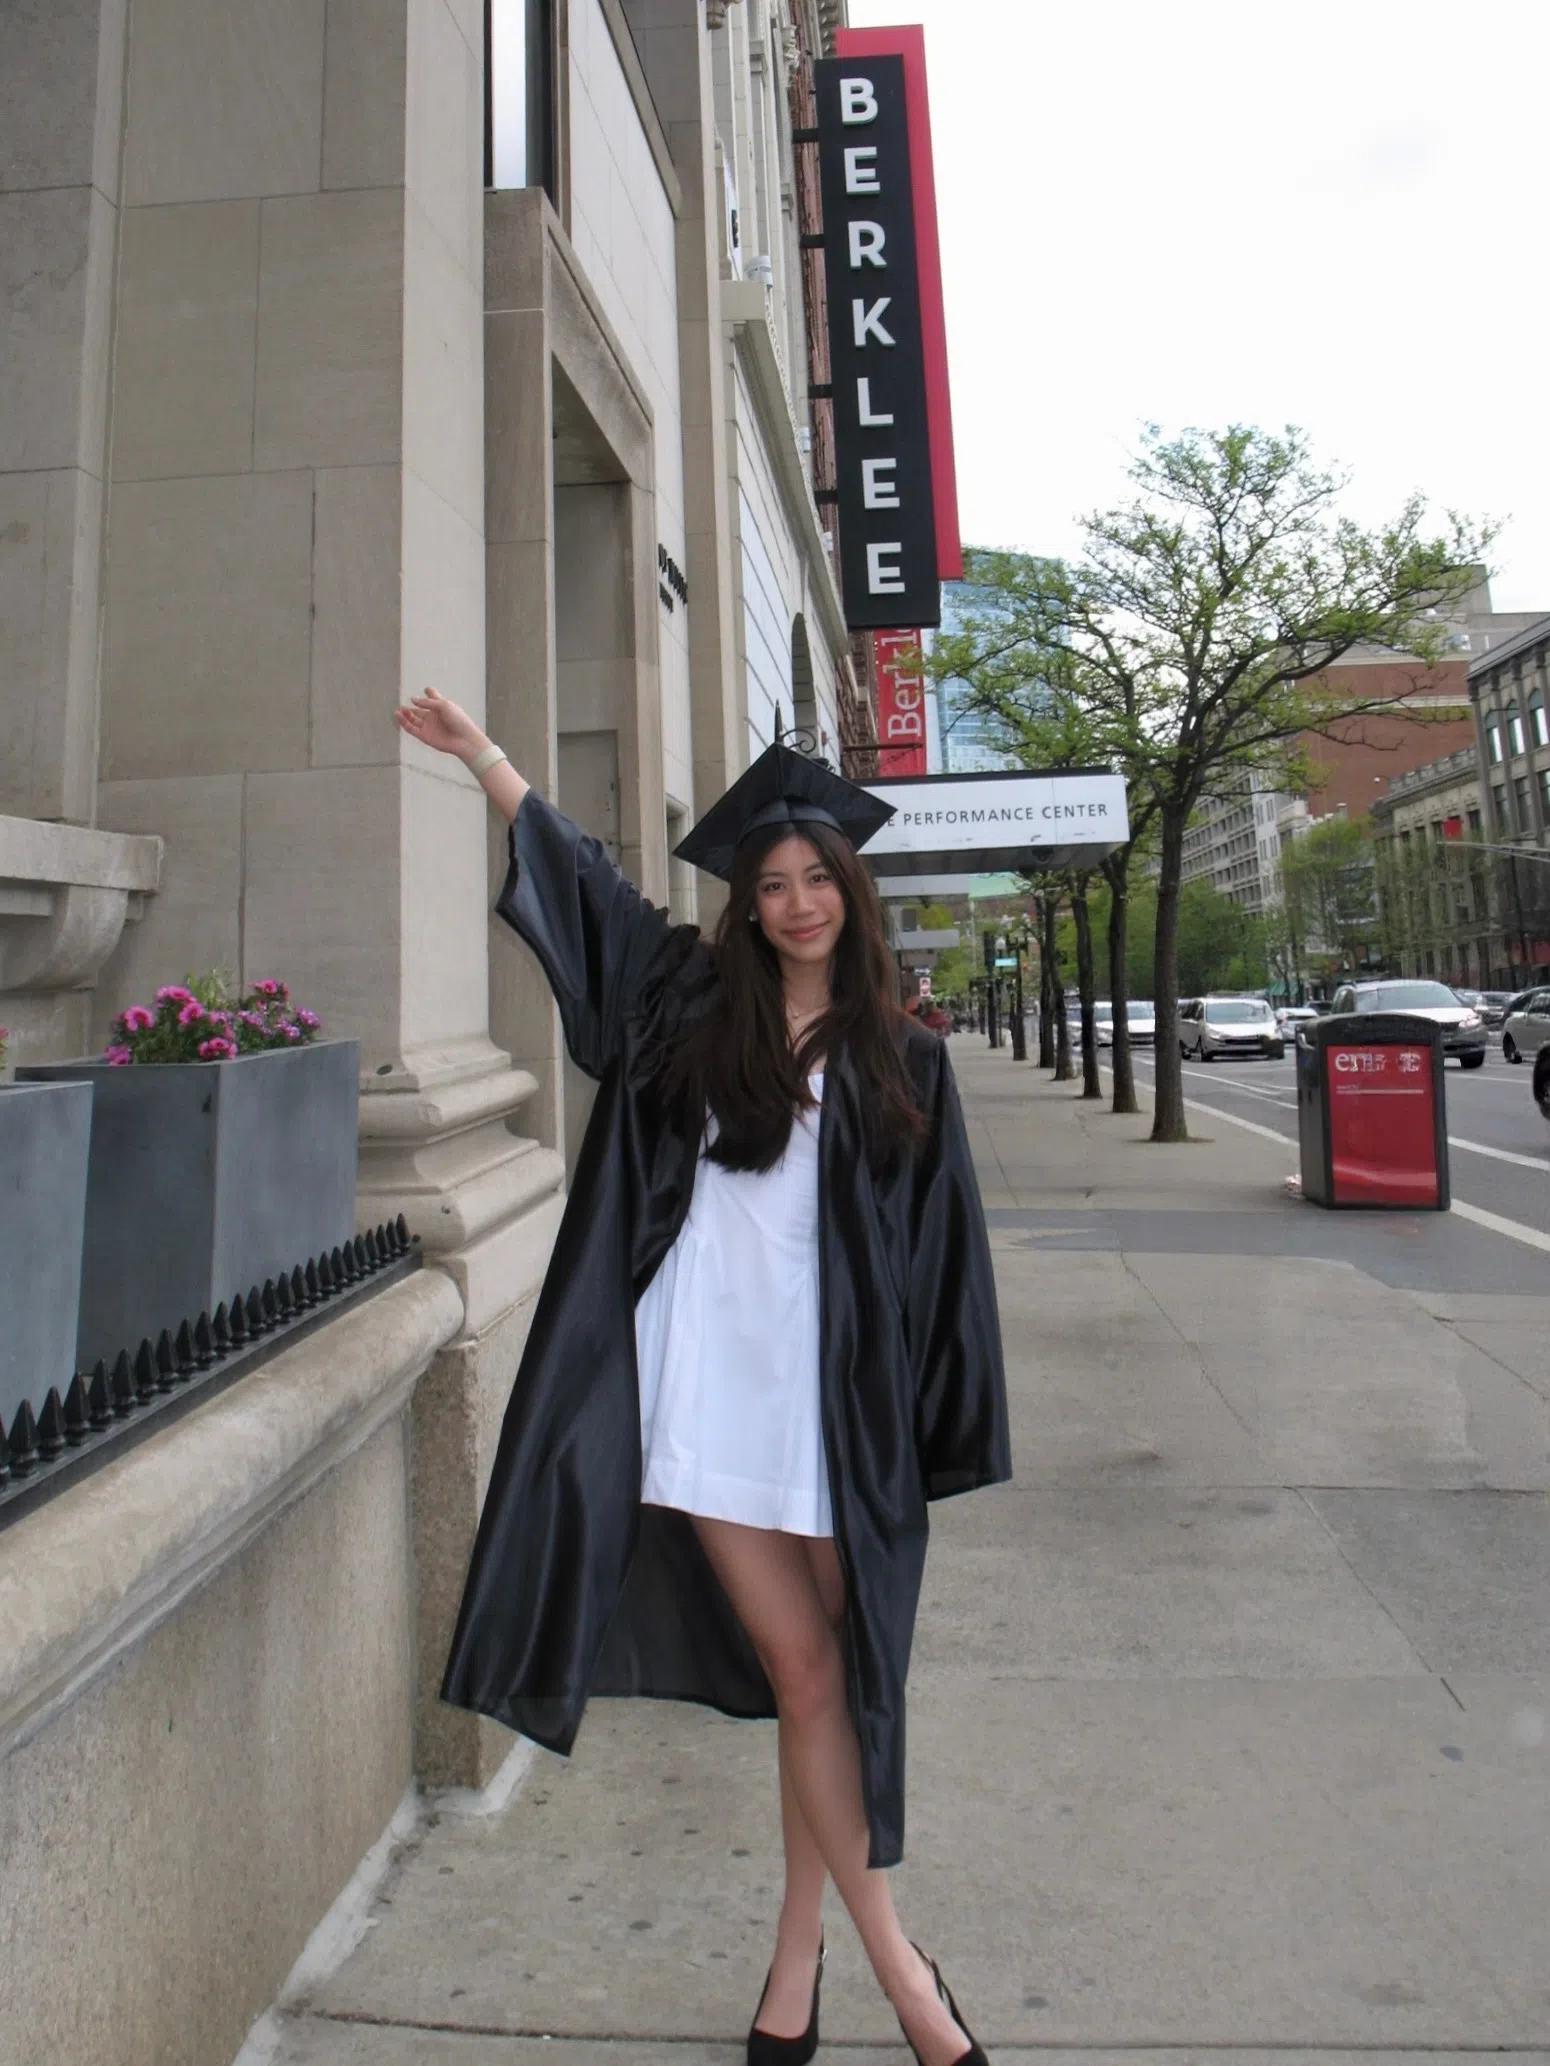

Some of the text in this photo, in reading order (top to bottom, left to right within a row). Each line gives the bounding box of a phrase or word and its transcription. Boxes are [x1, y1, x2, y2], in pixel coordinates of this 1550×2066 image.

[840, 77, 905, 595] BERKLEE
[903, 806, 1034, 826] PERFORMANCE
[1041, 803, 1108, 820] CENTER
